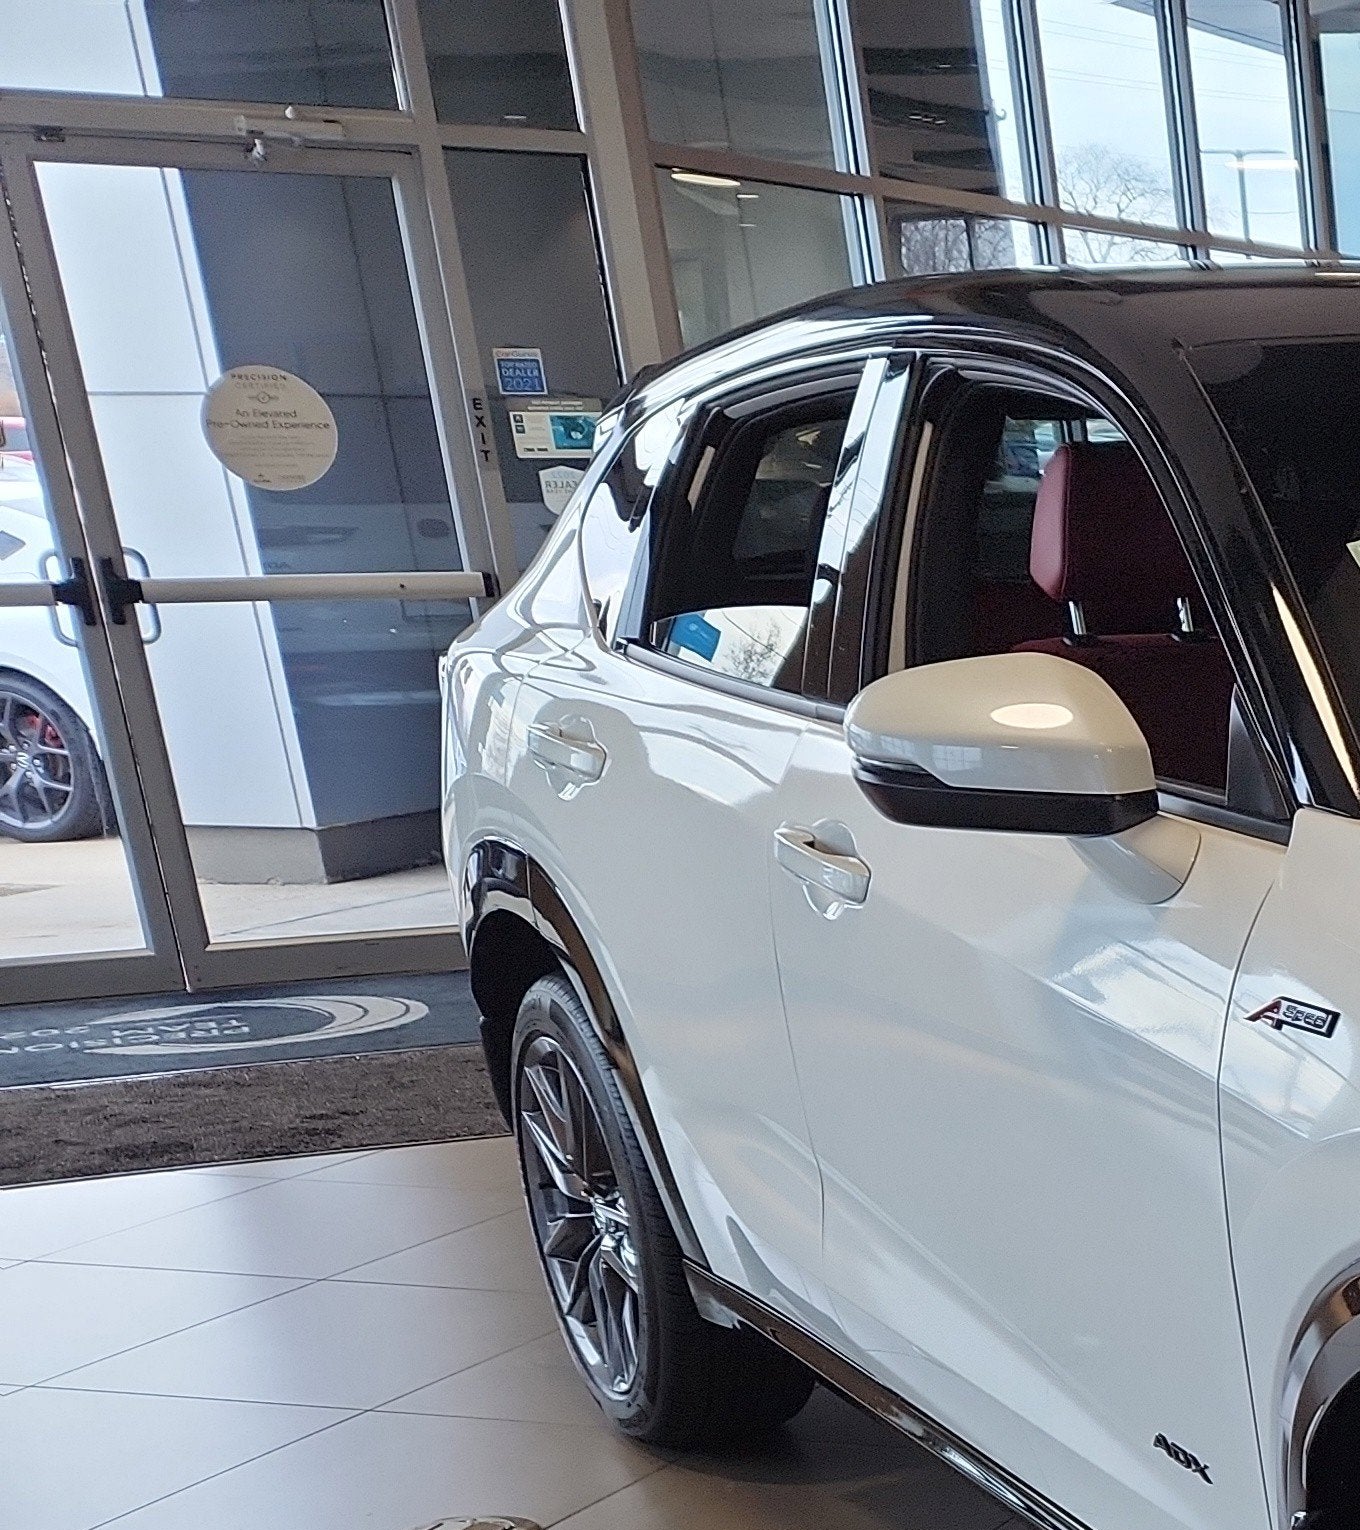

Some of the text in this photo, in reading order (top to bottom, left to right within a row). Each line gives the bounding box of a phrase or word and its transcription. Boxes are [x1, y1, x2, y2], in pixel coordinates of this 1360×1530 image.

[501, 368, 539, 377] DEALER
[505, 378, 541, 390] 2021
[252, 408, 298, 418] Elevated
[205, 419, 330, 430] Pre-Owned Experience
[473, 398, 491, 462] EXIT
[1152, 1432, 1214, 1485] ADX
